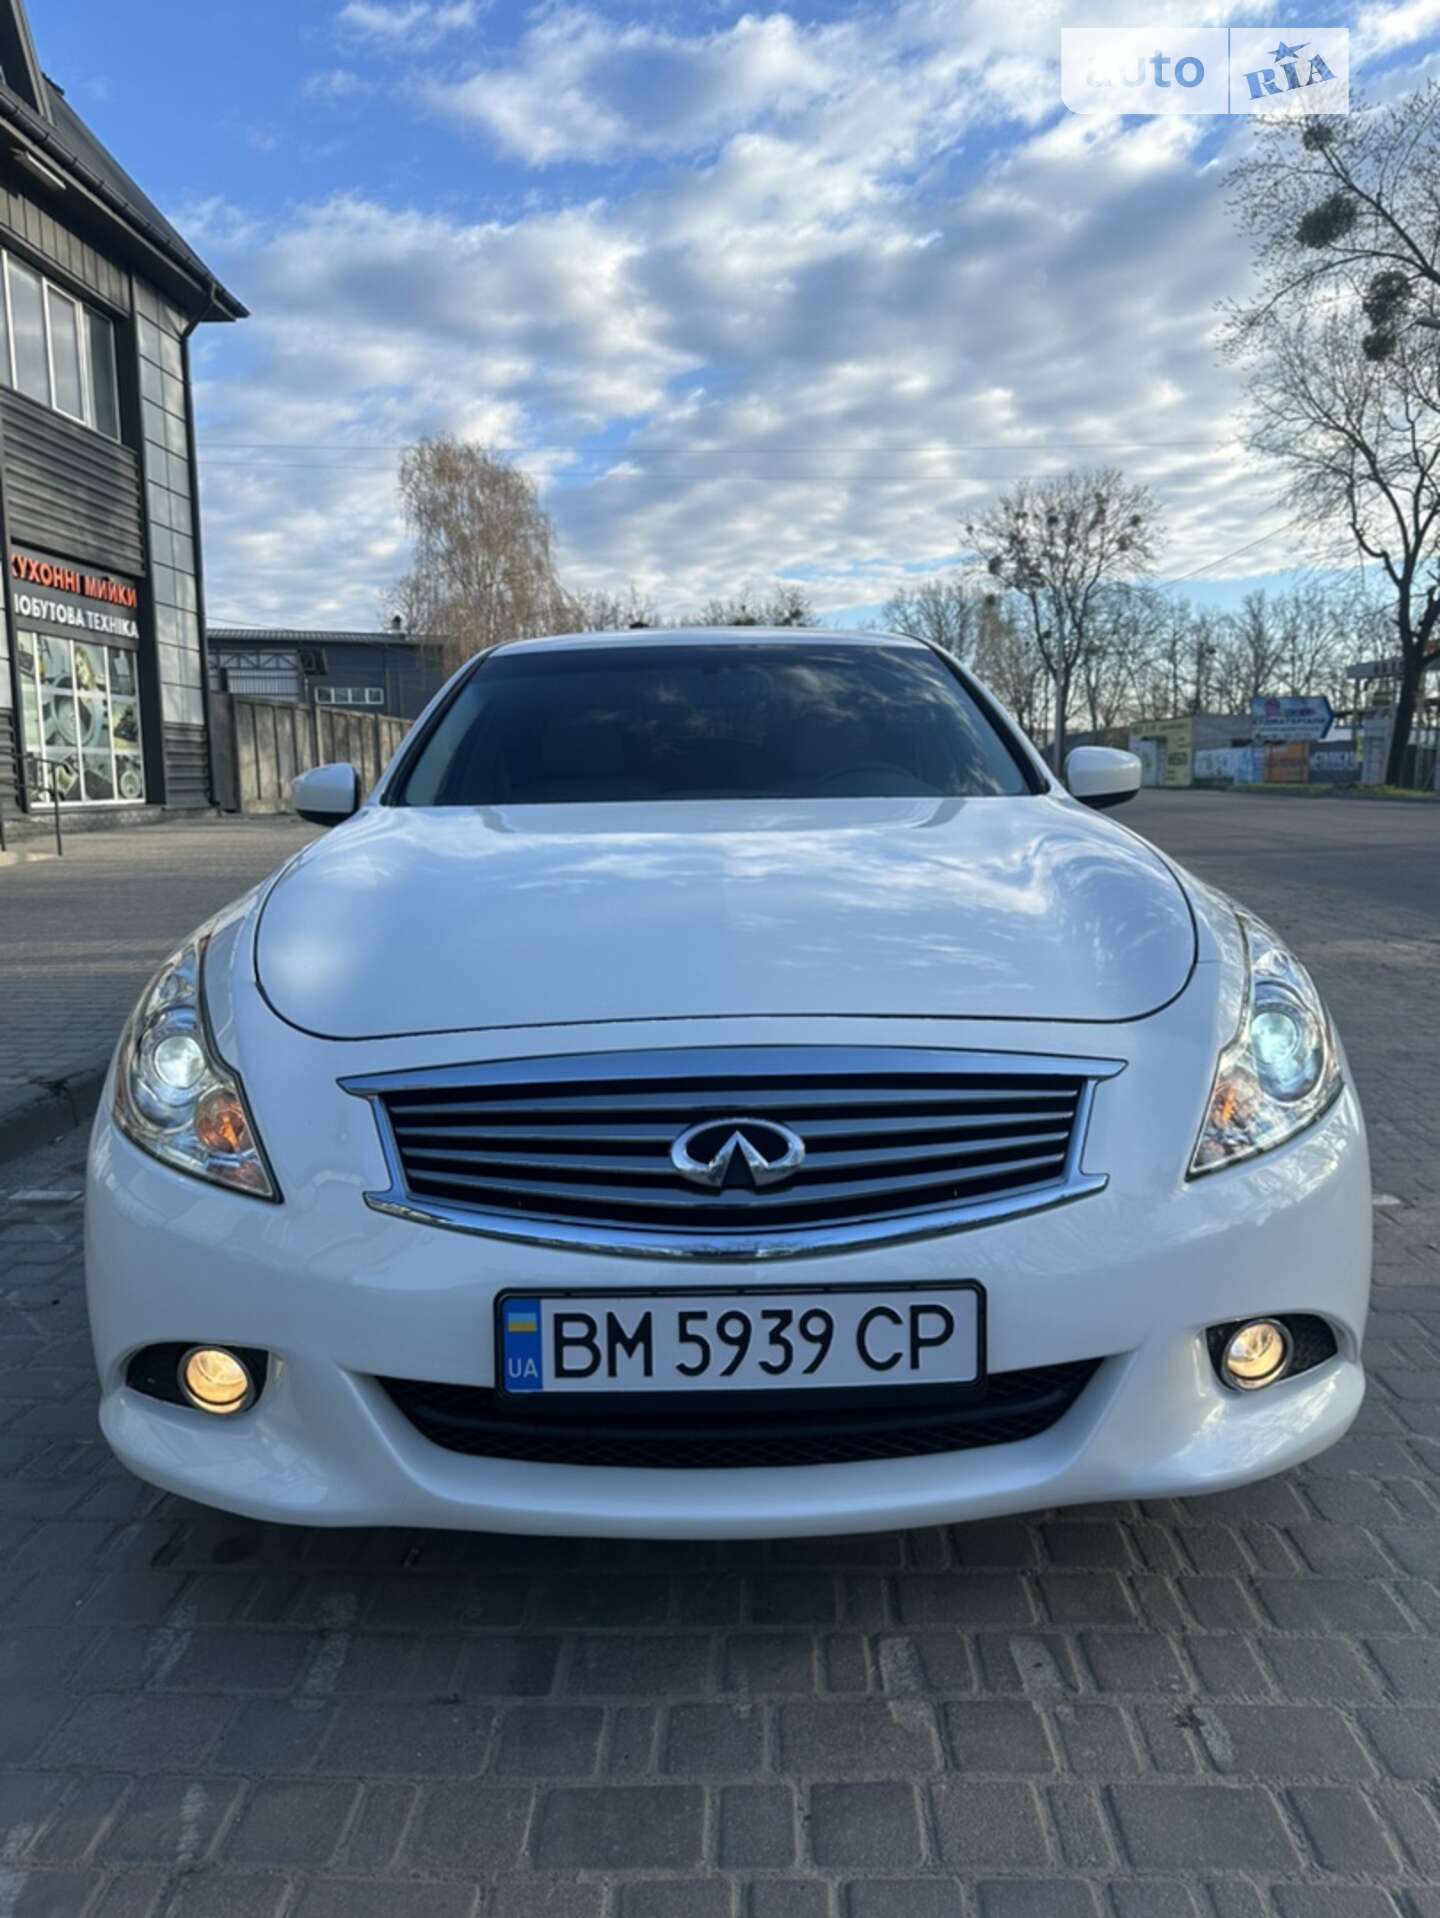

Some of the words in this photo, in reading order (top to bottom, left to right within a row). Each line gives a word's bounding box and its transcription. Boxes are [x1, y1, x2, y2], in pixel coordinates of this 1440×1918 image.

[85, 574, 137, 608] МИЙКИ
[86, 609, 139, 639] ТЕХНІКА
[553, 1311, 653, 1379] BM
[675, 1308, 834, 1377] 5939
[855, 1304, 955, 1372] CP
[508, 1358, 538, 1379] UA
